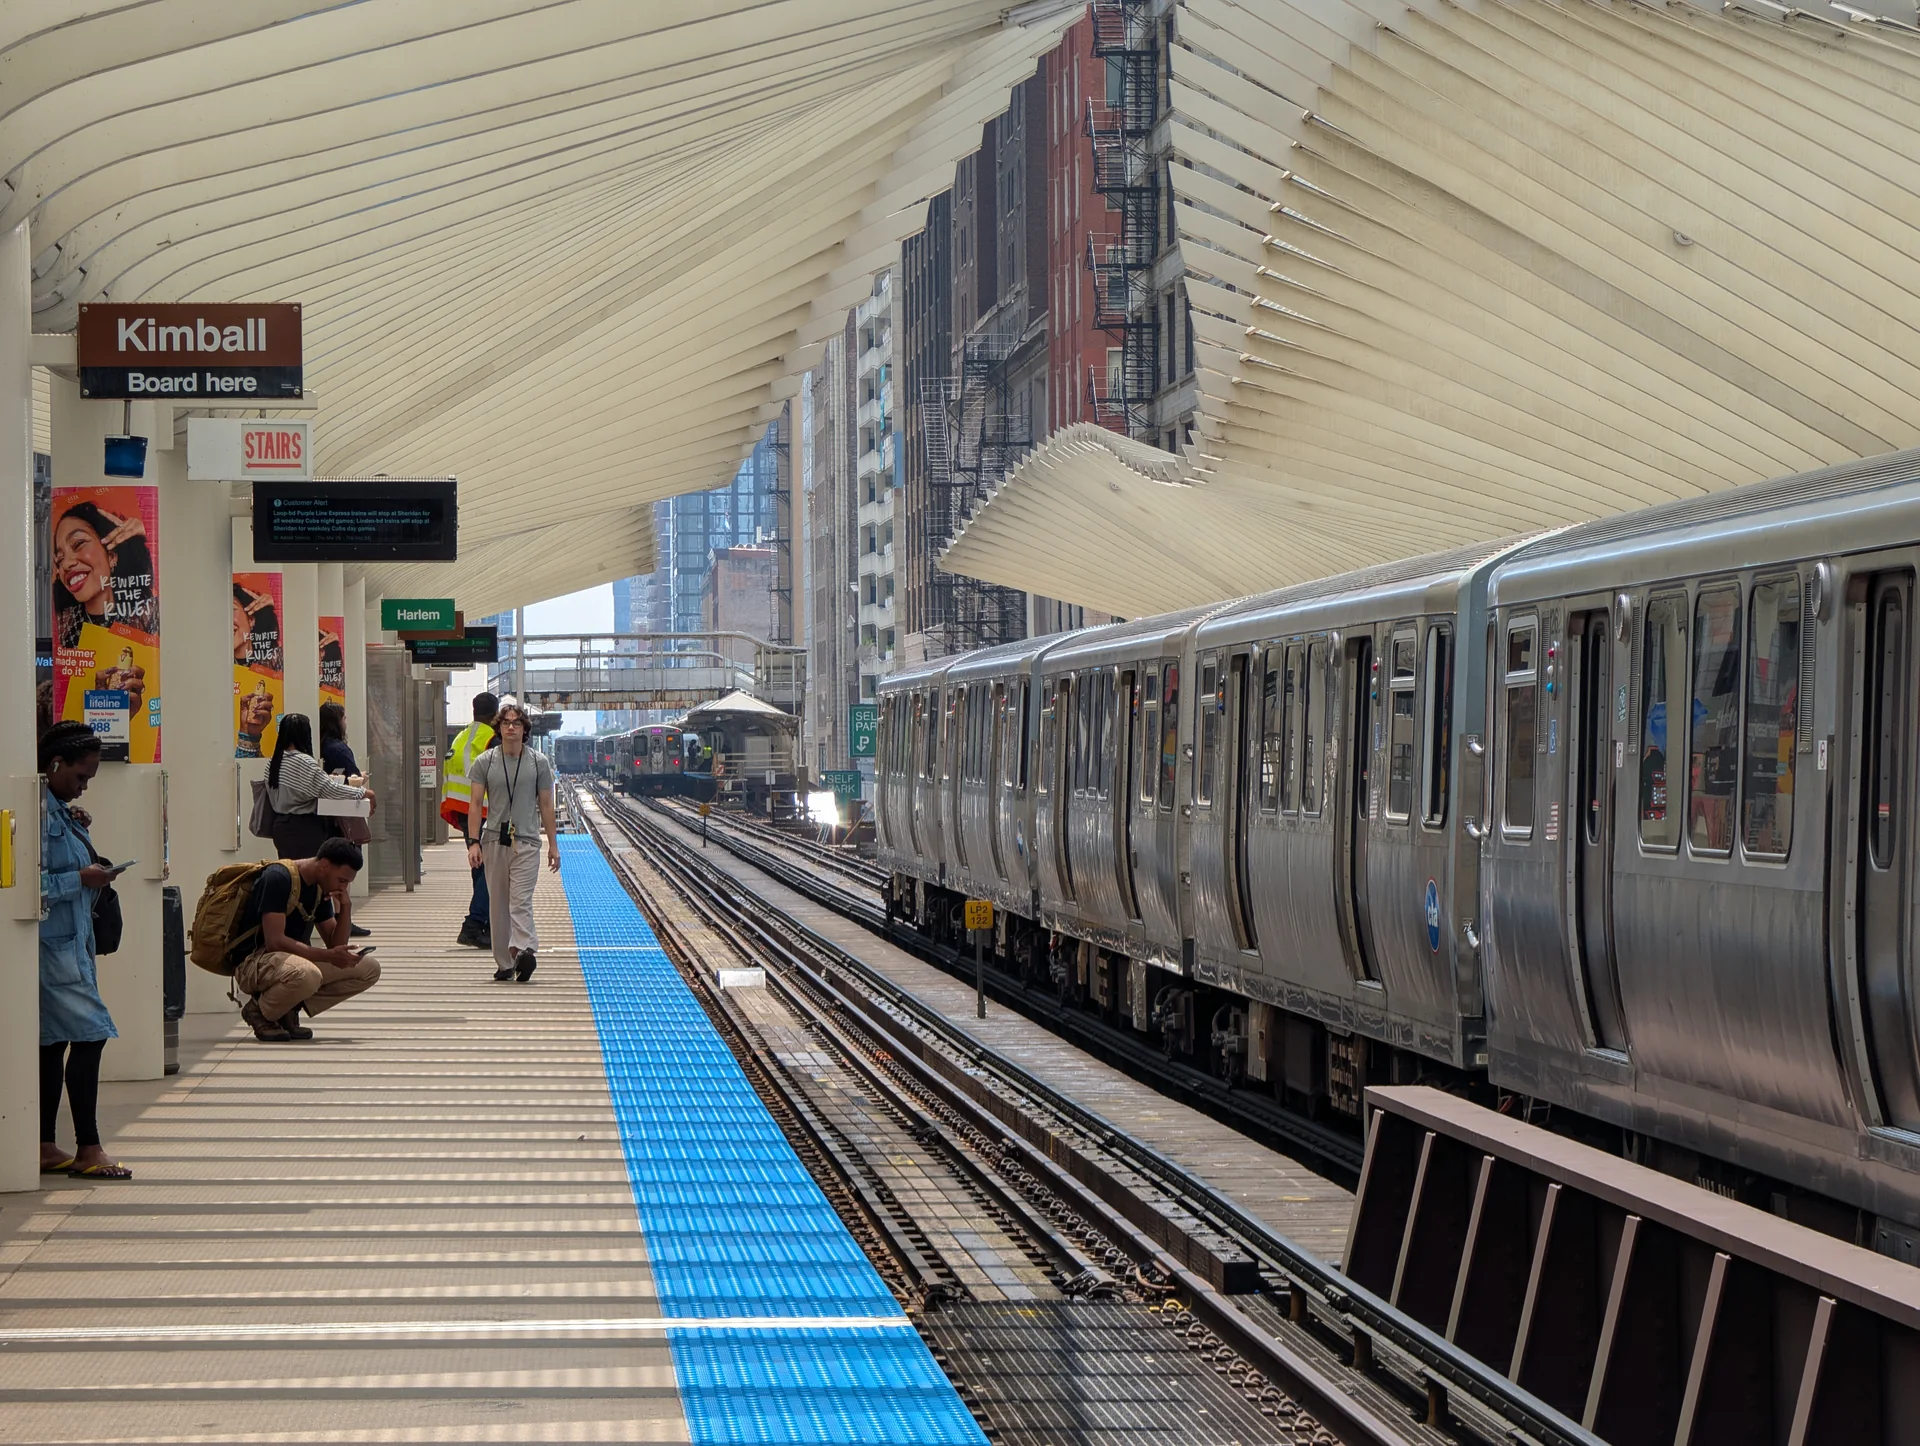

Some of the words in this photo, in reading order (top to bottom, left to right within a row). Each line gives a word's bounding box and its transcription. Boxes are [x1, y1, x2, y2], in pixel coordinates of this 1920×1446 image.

[117, 318, 267, 352] Kimball
[128, 372, 197, 392] Board
[206, 372, 257, 392] here
[244, 431, 302, 460] STAIRS
[100, 574, 152, 591] REWRITE
[114, 589, 142, 600] THE
[103, 599, 152, 620] RULES
[397, 609, 440, 621] Harlem
[243, 631, 278, 642] REWRITE
[253, 641, 272, 650] THE
[57, 647, 95, 659] Summer
[245, 647, 279, 662] RULES
[56, 658, 77, 666] made
[79, 659, 95, 668] me
[62, 667, 73, 676] do
[75, 667, 85, 676] it.
[89, 699, 120, 708] lifeline
[89, 722, 111, 733] 988
[827, 774, 854, 784] SELF
[827, 784, 856, 794] PARK
[970, 905, 988, 914] LP2
[971, 917, 988, 925] 122
